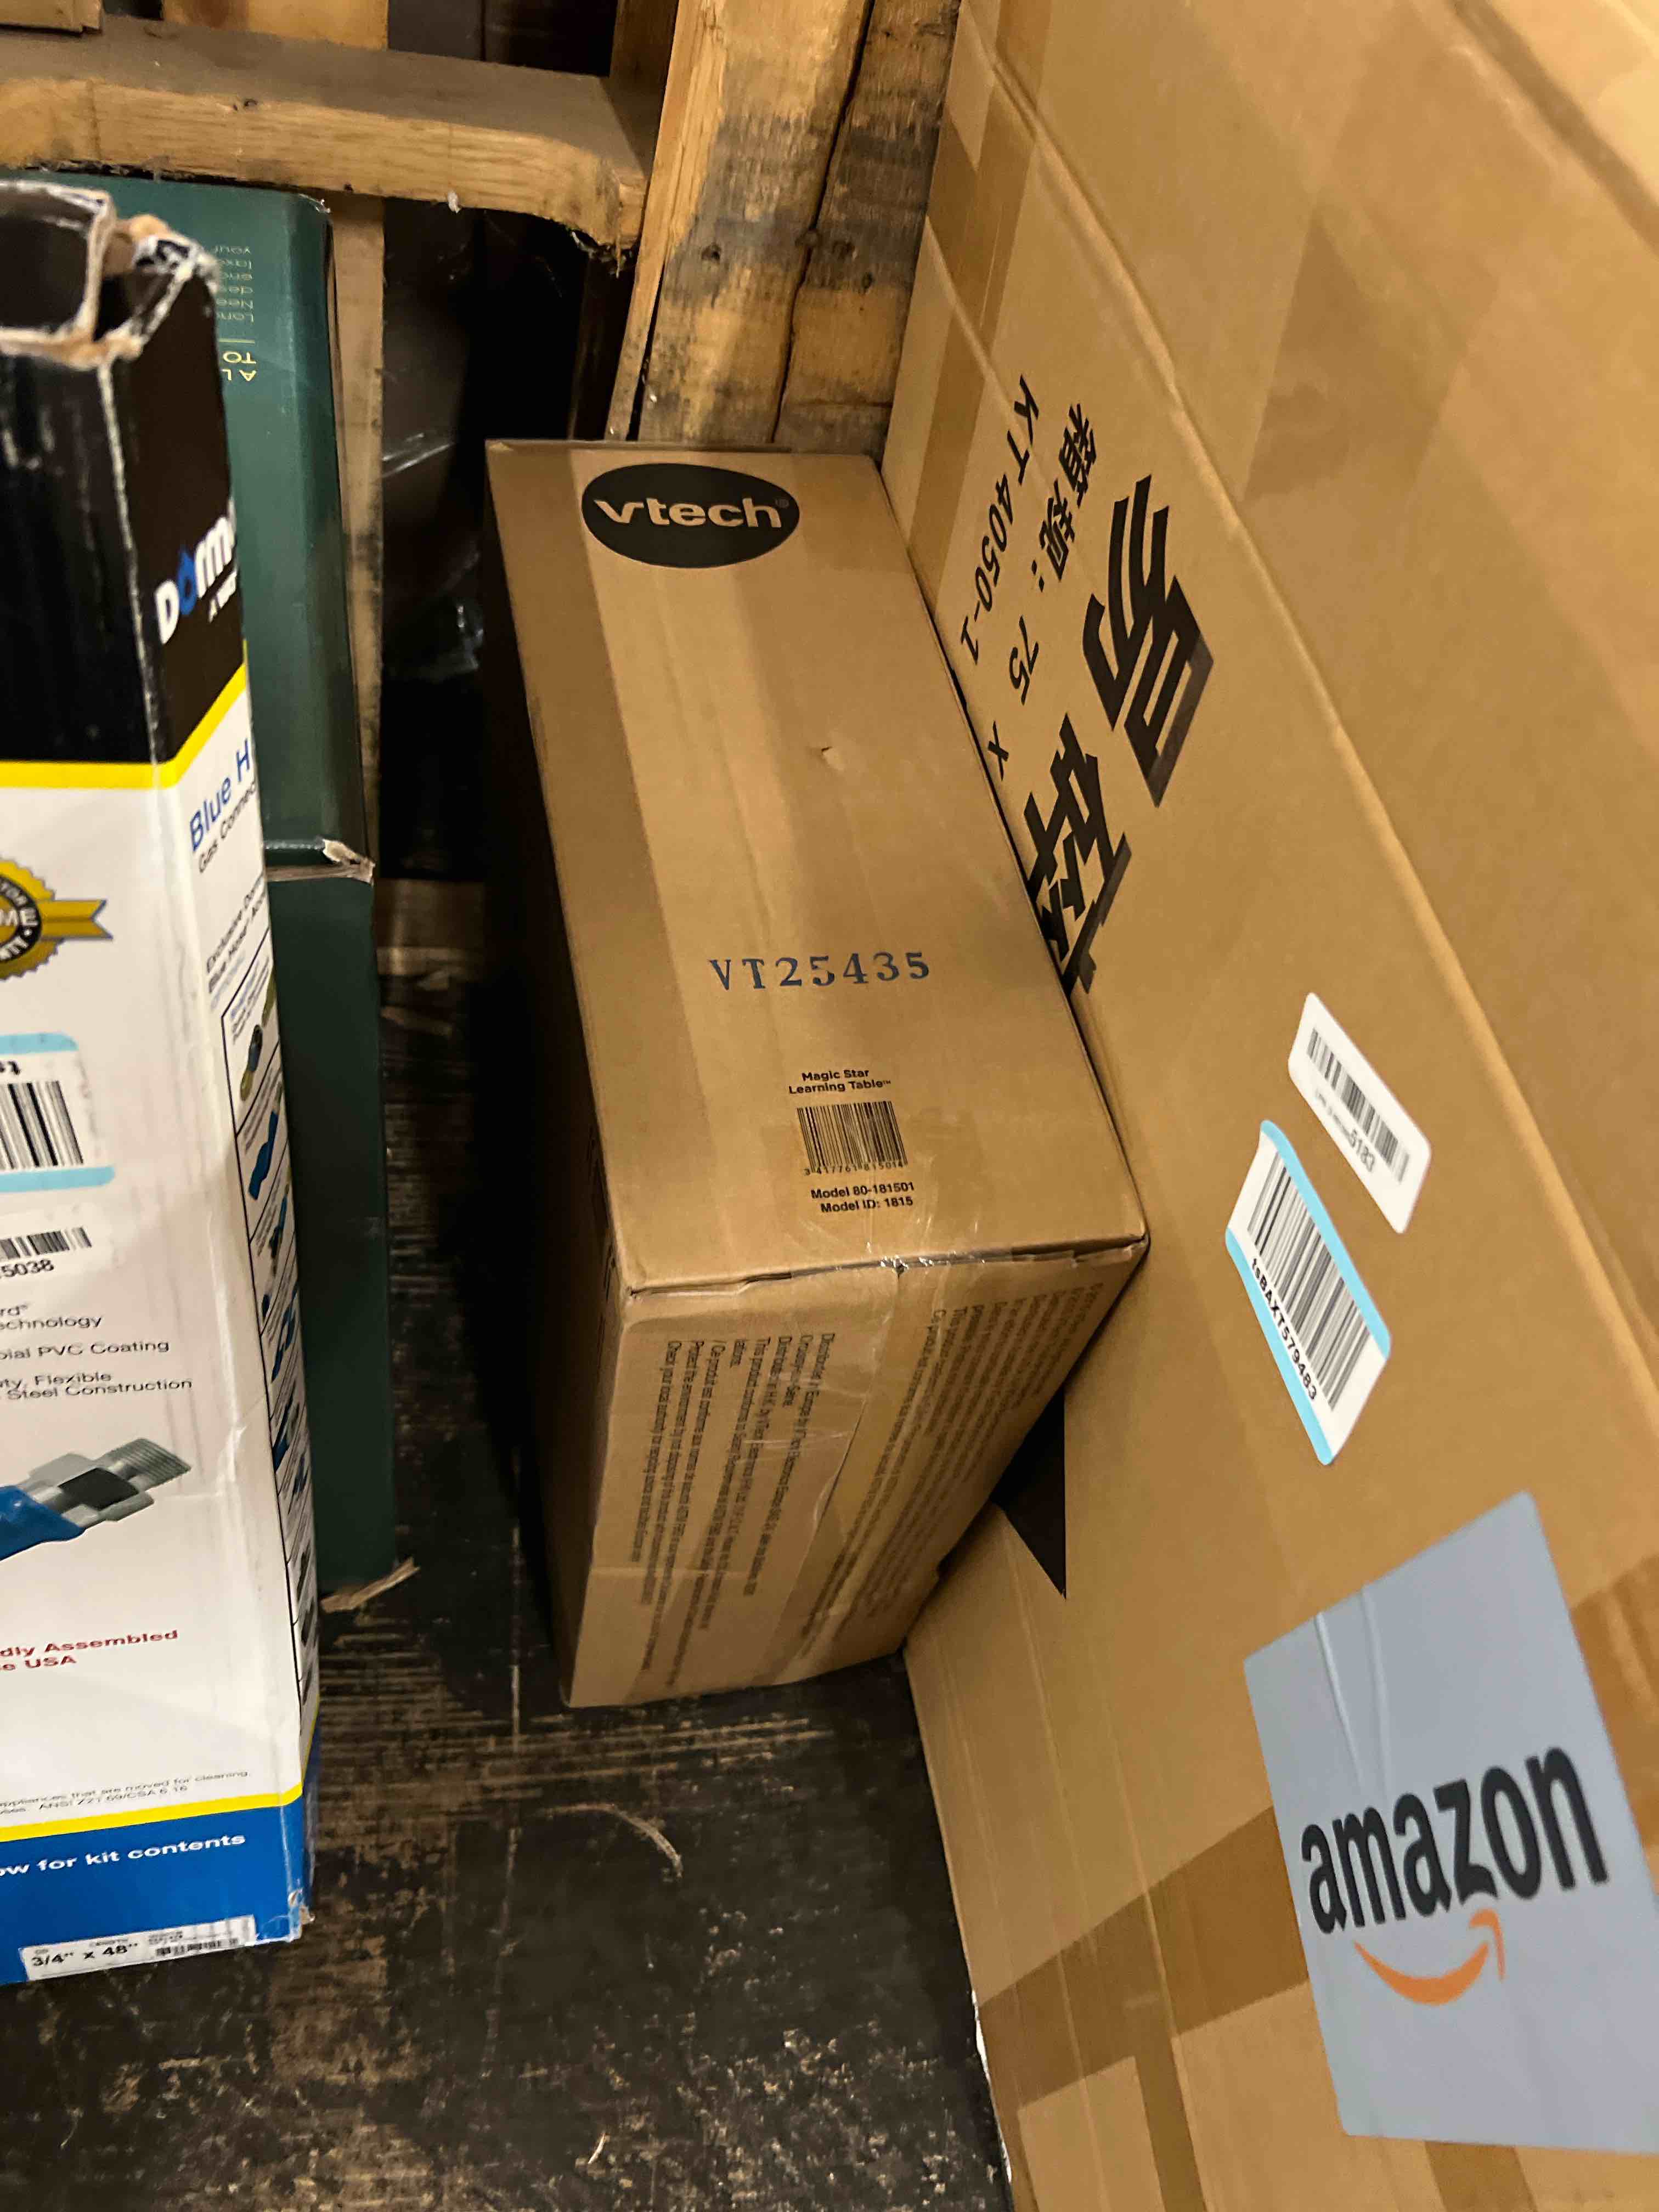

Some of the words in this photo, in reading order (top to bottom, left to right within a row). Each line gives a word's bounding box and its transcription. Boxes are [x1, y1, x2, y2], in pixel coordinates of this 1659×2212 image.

[593, 498, 782, 528] vtech
[1009, 615, 1040, 706] 75
[190, 776, 231, 851] Blue
[198, 839, 218, 874] Gas
[707, 951, 930, 991] VT25435
[802, 1071, 840, 1081] Magic
[844, 1069, 870, 1078] Star
[788, 1083, 846, 1094] Learning
[811, 1187, 850, 1199] Model
[853, 1182, 915, 1196] 80-181501
[821, 1200, 860, 1213] Model
[863, 1199, 881, 1210] ID:
[884, 1196, 913, 1207] 1815
[0, 1258, 54, 1278] 5038
[38, 1344, 83, 1357] PVC
[91, 1341, 170, 1354] Coating
[35, 1372, 112, 1385] Flexible
[7, 1387, 58, 1400] Steel
[65, 1379, 192, 1396] Construction
[44, 1630, 179, 1652] Assembled
[25, 1655, 77, 1669] USA
[1301, 1747, 1609, 1935] amazon
[38, 1856, 77, 1871] for
[85, 1850, 120, 1865] kit
[127, 1833, 246, 1859] contents
